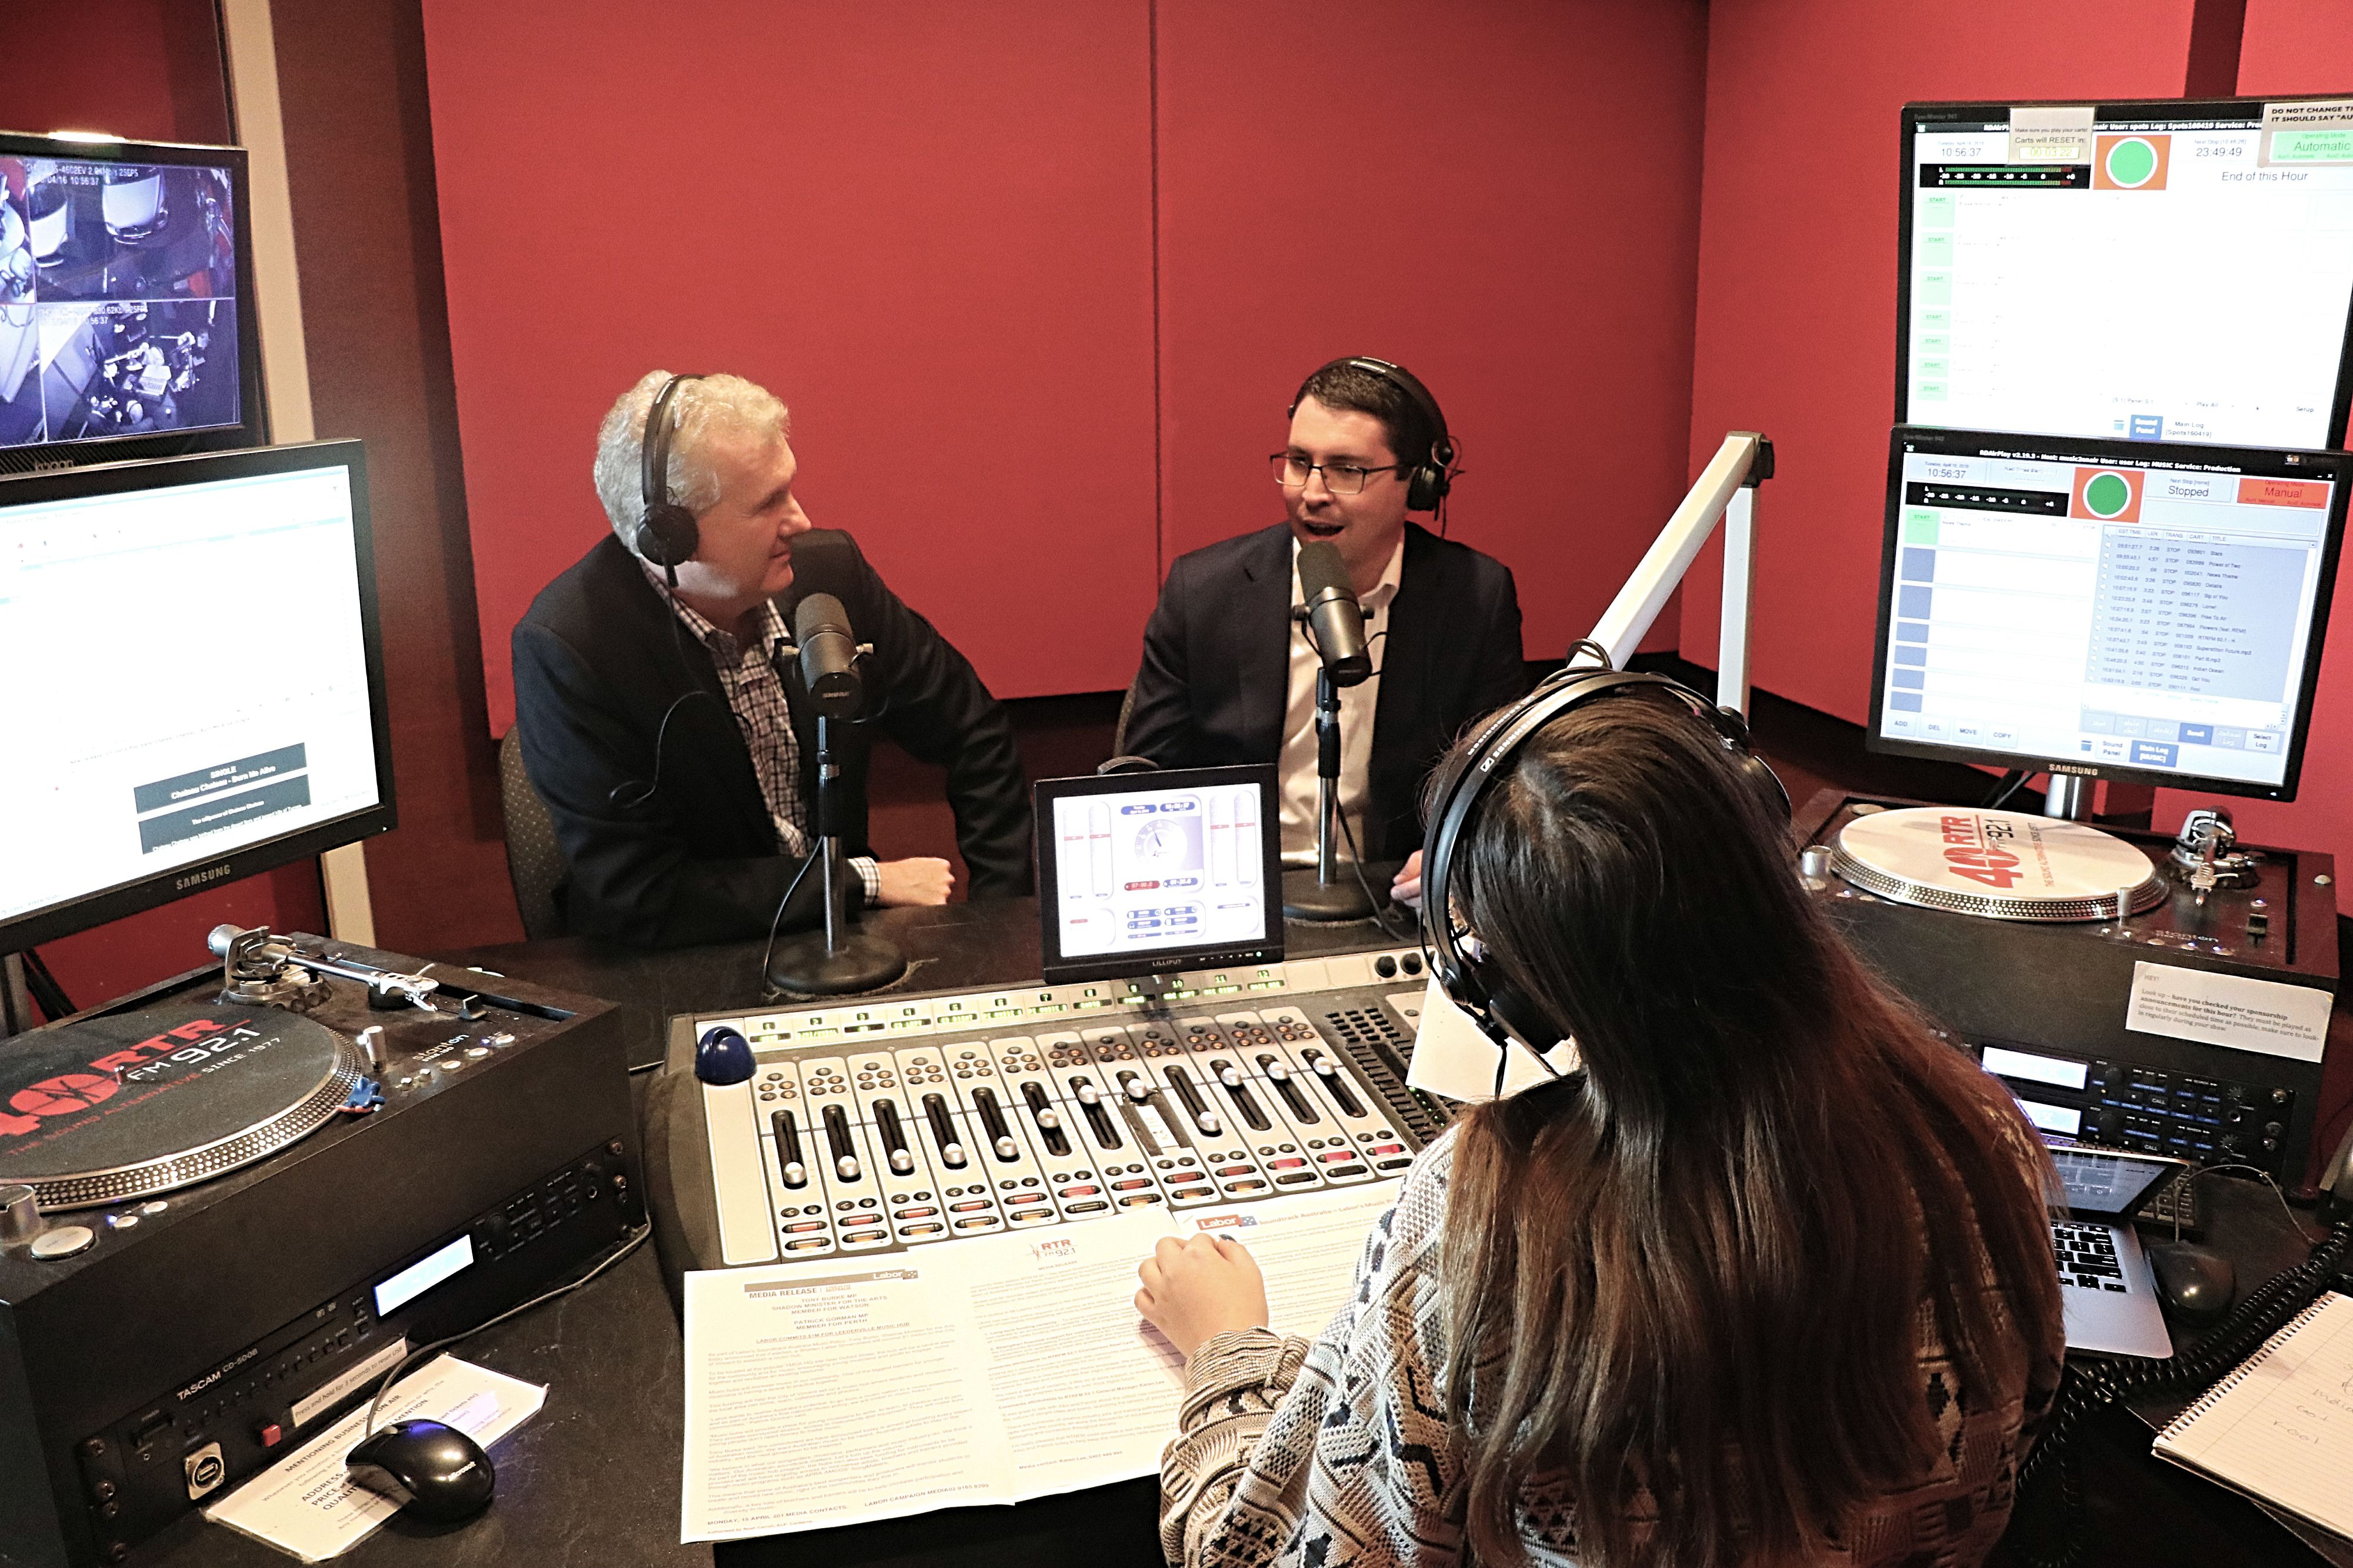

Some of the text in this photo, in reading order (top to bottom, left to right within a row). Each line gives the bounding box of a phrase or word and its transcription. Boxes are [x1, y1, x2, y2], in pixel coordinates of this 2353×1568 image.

[1941, 147, 1981, 157] 10:56:37
[2196, 147, 2242, 158] 23:49:49
[2294, 141, 2351, 151] Automatic
[2221, 171, 2309, 181] End of this Hour
[35, 459, 75, 471] kogan
[1928, 468, 1966, 479] 10:56:37
[2168, 485, 2209, 498] Stopped
[2264, 487, 2302, 499] Manual
[2102, 740, 2123, 749] Sound
[2255, 741, 2268, 749] Log
[2103, 749, 2121, 757] Panel
[210, 766, 237, 779] SINGLE
[259, 765, 276, 776] Alive
[2048, 763, 2098, 776] SAMSUNG
[1941, 816, 1975, 845] RTR
[1984, 819, 2014, 839] 92.1
[1943, 847, 2024, 889] 40
[176, 863, 231, 891] SAMSUNG
[2155, 930, 2219, 943] stanton
[1152, 958, 1182, 966] LILLIPUT
[1172, 980, 1184, 988] 10
[1215, 975, 1227, 983] 11
[2144, 973, 2159, 982] HEY!
[2141, 988, 2157, 997] Look
[2172, 994, 2187, 1002] have
[2188, 996, 2201, 1006] you
[2202, 999, 2229, 1010] checked
[2229, 1005, 2246, 1013] your
[2247, 1007, 2288, 1021] sponsorship
[2140, 996, 2191, 1011] announcements
[2192, 1005, 2203, 1013] for
[2204, 1007, 2216, 1015] this
[2217, 1009, 2237, 1019] hour?
[2239, 1013, 2255, 1024] They
[2255, 1017, 2272, 1025] must
[2281, 1021, 2302, 1032] played
[2139, 1003, 2154, 1012] close
[2162, 1006, 2177, 1015] their
[2178, 1009, 2209, 1022] scheduled
[2210, 1015, 2224, 1024] time
[2261, 1025, 2279, 1035] make
[2302, 1032, 2319, 1042] look-
[2145, 1012, 2172, 1024] regularly
[2172, 1016, 2194, 1028] during
[2194, 1022, 2209, 1030] your
[2209, 1023, 2227, 1032] show
[89, 1018, 227, 1072] RTR
[412, 1033, 470, 1060] stanton
[127, 1027, 261, 1082] FM 92.1
[202, 1037, 281, 1073] SINCE 1977
[1258, 1200, 1387, 1226] Soundtrack Australia Labor's Music
[1200, 1216, 1237, 1229] Labor
[1041, 1239, 1072, 1251] RTR
[1055, 1247, 1076, 1257] 92.1
[873, 1270, 903, 1280] Labor
[749, 1290, 778, 1299] MEDIA
[779, 1287, 818, 1297] RELEASE
[791, 1307, 819, 1315] MEMBER
[837, 1302, 869, 1310] WATSON
[804, 1300, 836, 1309] MINISTER
[794, 1318, 825, 1326] PATRICK
[825, 1315, 857, 1323] GORMAN
[835, 1327, 876, 1337] LEEDERVILLE
[176, 1347, 259, 1402] TASCAM CD-500B
[394, 1399, 429, 1422] MENTION
[448, 1461, 476, 1482] Microsoft
[262, 1480, 295, 1502] Whenever
[304, 1455, 332, 1472] mention
[301, 1472, 344, 1502] ADDRESS
[311, 1487, 340, 1507] PRICE
[864, 1491, 926, 1507] LABOR CAMPAIGN
